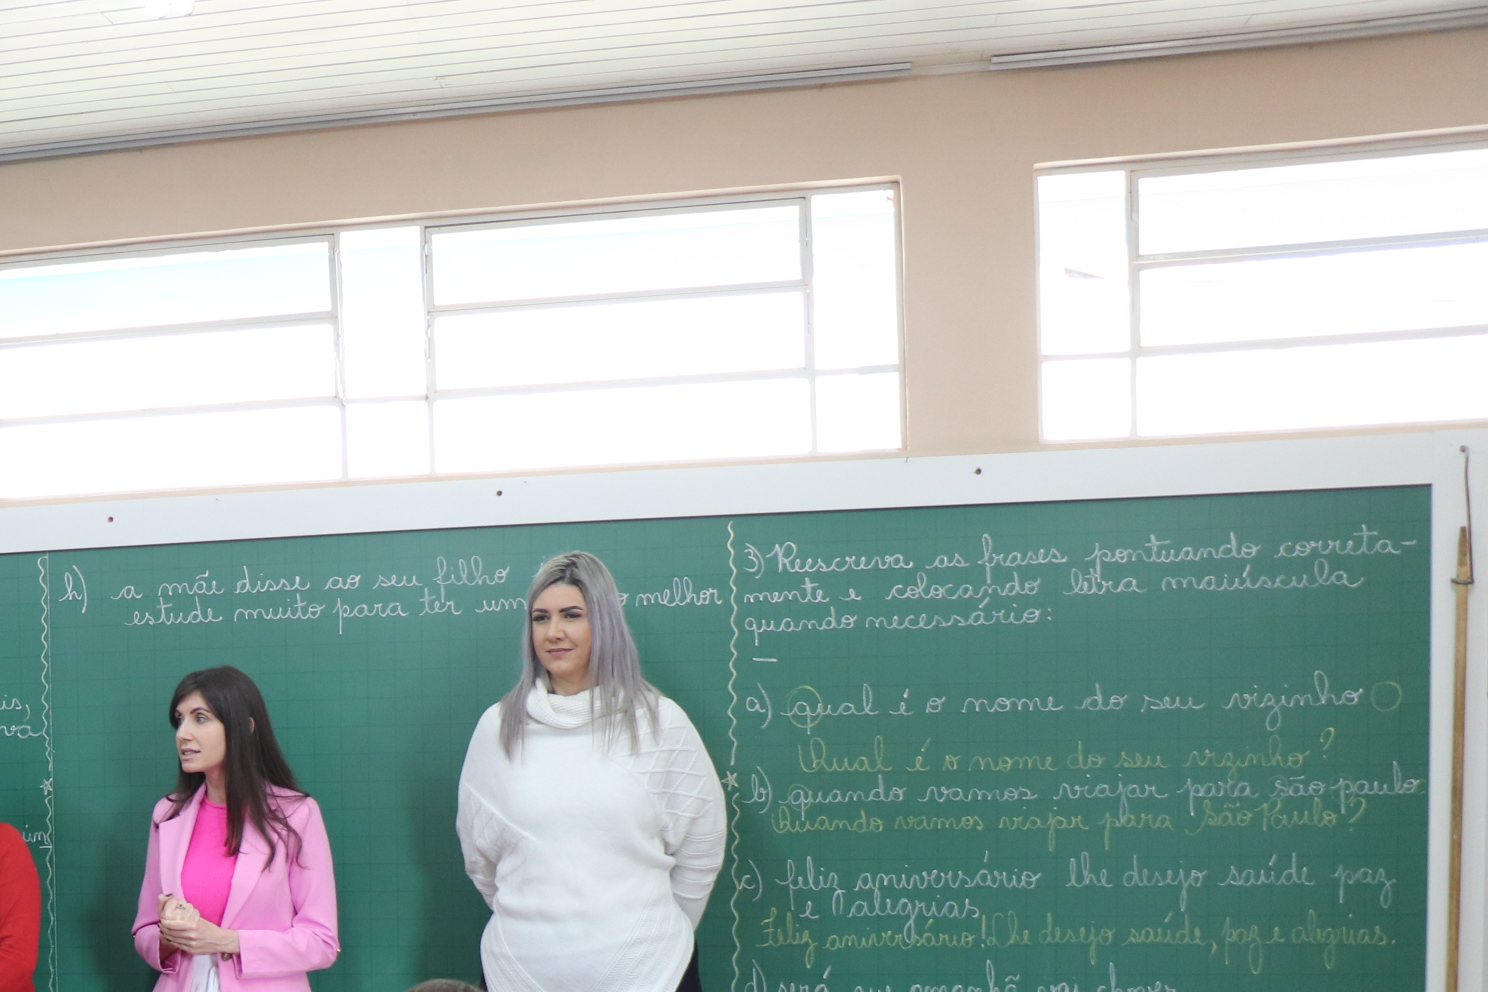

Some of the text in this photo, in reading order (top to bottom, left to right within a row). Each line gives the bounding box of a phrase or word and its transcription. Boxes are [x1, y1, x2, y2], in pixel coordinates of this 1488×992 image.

[110, 585, 143, 600] a
[159, 570, 224, 596] mãe
[233, 565, 310, 594] disse
[323, 574, 361, 590] ao
[372, 573, 423, 588] seu
[433, 556, 510, 603] filho
[744, 559, 1365, 604] mente e colocando letra maiúscula
[925, 553, 970, 569] as
[978, 534, 1068, 584] frases
[1085, 531, 1261, 583] pontuando
[124, 595, 223, 626] estude
[234, 592, 326, 622] muito
[332, 597, 409, 634] para
[419, 588, 463, 616] ter
[636, 577, 723, 607] melhor
[744, 606, 858, 646] quando
[746, 682, 772, 729] a)
[780, 683, 879, 735] qual
[889, 688, 913, 715] é
[961, 695, 1063, 714] nome
[1075, 682, 1127, 710] do
[1141, 692, 1206, 713] seu
[1221, 670, 1363, 731] vizinho
[798, 735, 892, 772] Qual
[906, 737, 931, 771] é
[968, 754, 1059, 772] nome
[1067, 740, 1106, 770] do
[1114, 751, 1169, 769] seu
[778, 774, 907, 820] quando
[917, 786, 1038, 802] vamos
[1053, 773, 1168, 822] viajar
[1176, 778, 1259, 816] para
[1331, 761, 1424, 814] paulo
[772, 805, 884, 833] Quando
[894, 815, 984, 831] vamos
[999, 806, 1089, 851] viajar
[1099, 811, 1175, 850] para
[775, 855, 846, 915] feliz
[853, 850, 1041, 890] aniversário
[1066, 852, 1112, 887] lhe
[1123, 854, 1207, 912] desejo
[1217, 852, 1315, 887] saúde
[1330, 864, 1396, 908] paz
[847, 890, 979, 944] alegrias
[1039, 912, 1115, 965] desejo
[1221, 916, 1262, 974] paz
